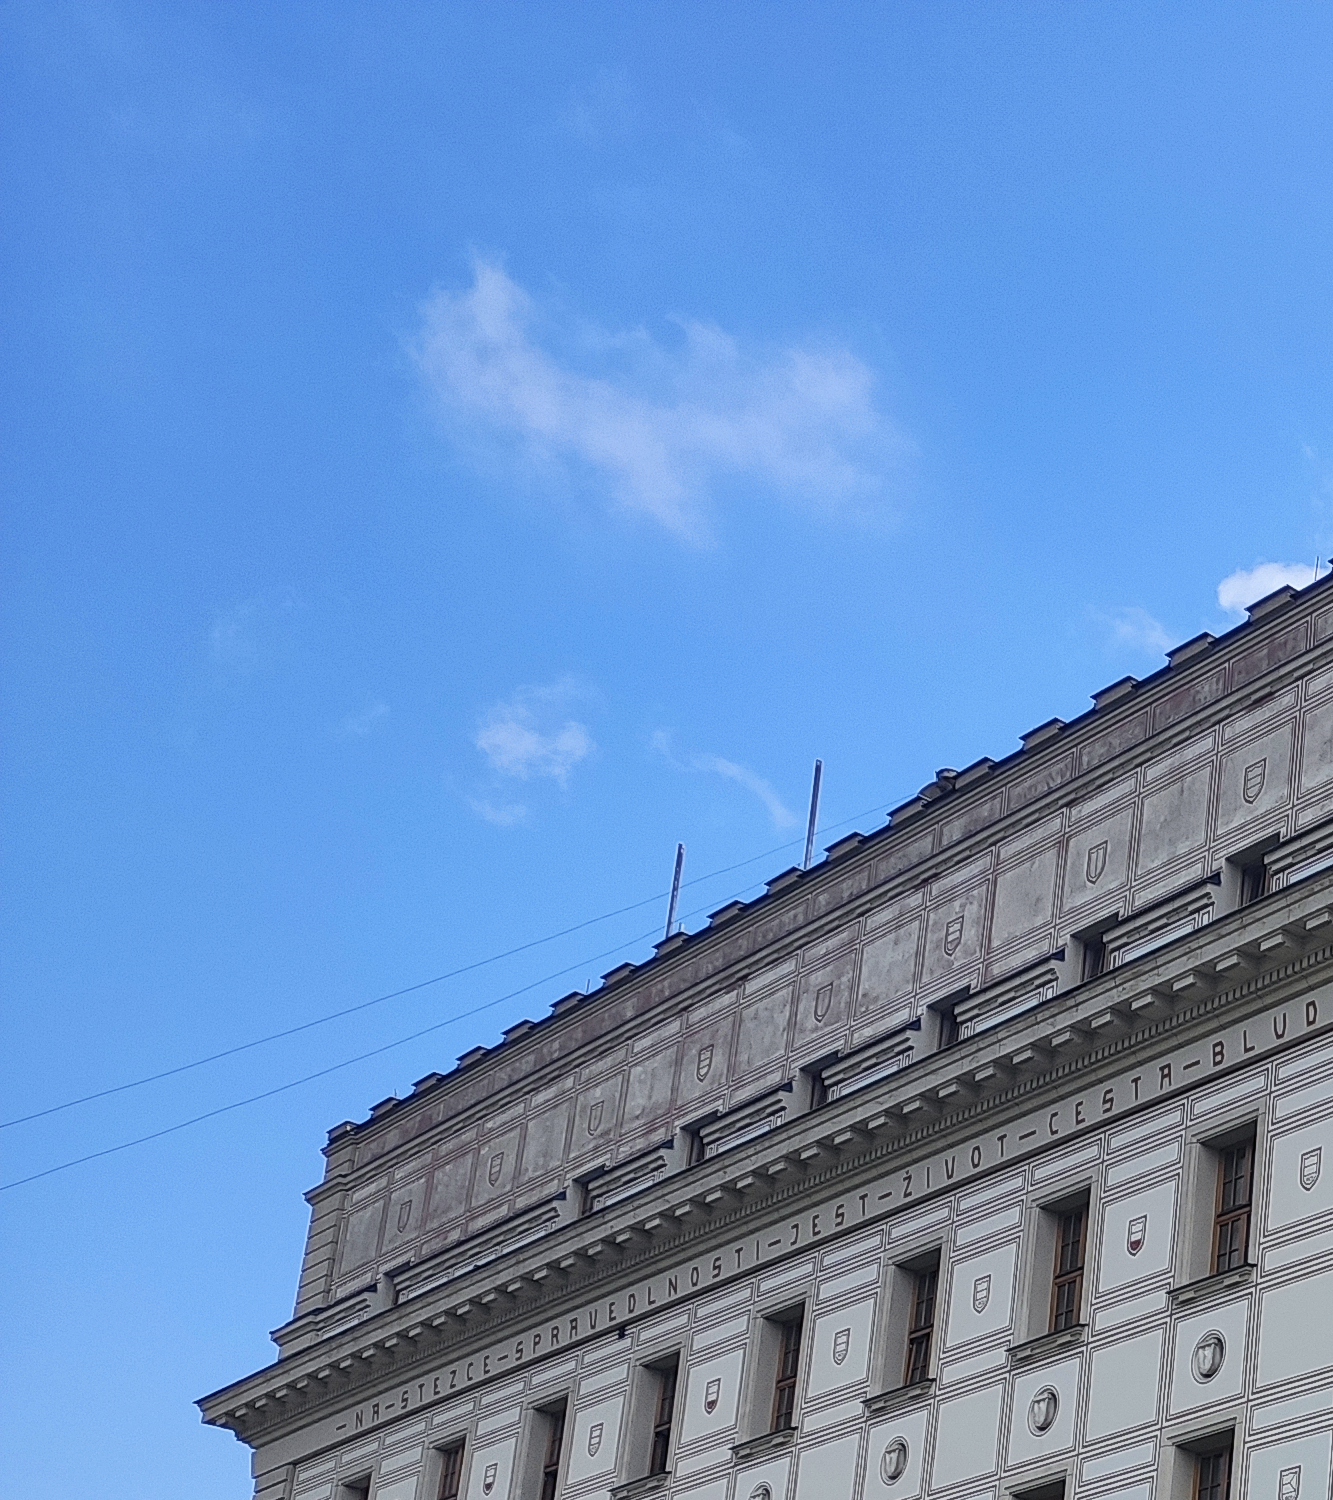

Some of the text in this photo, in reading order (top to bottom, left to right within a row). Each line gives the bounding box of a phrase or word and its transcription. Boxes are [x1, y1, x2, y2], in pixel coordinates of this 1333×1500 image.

[355, 1402, 380, 1430] NA
[400, 1355, 491, 1410] STEZCE
[514, 1240, 760, 1361] SPRAVEDLNOSTI
[790, 1193, 868, 1246] JEST
[902, 1134, 1007, 1198] ŽIVOT
[1048, 1062, 1172, 1136] CESTA
